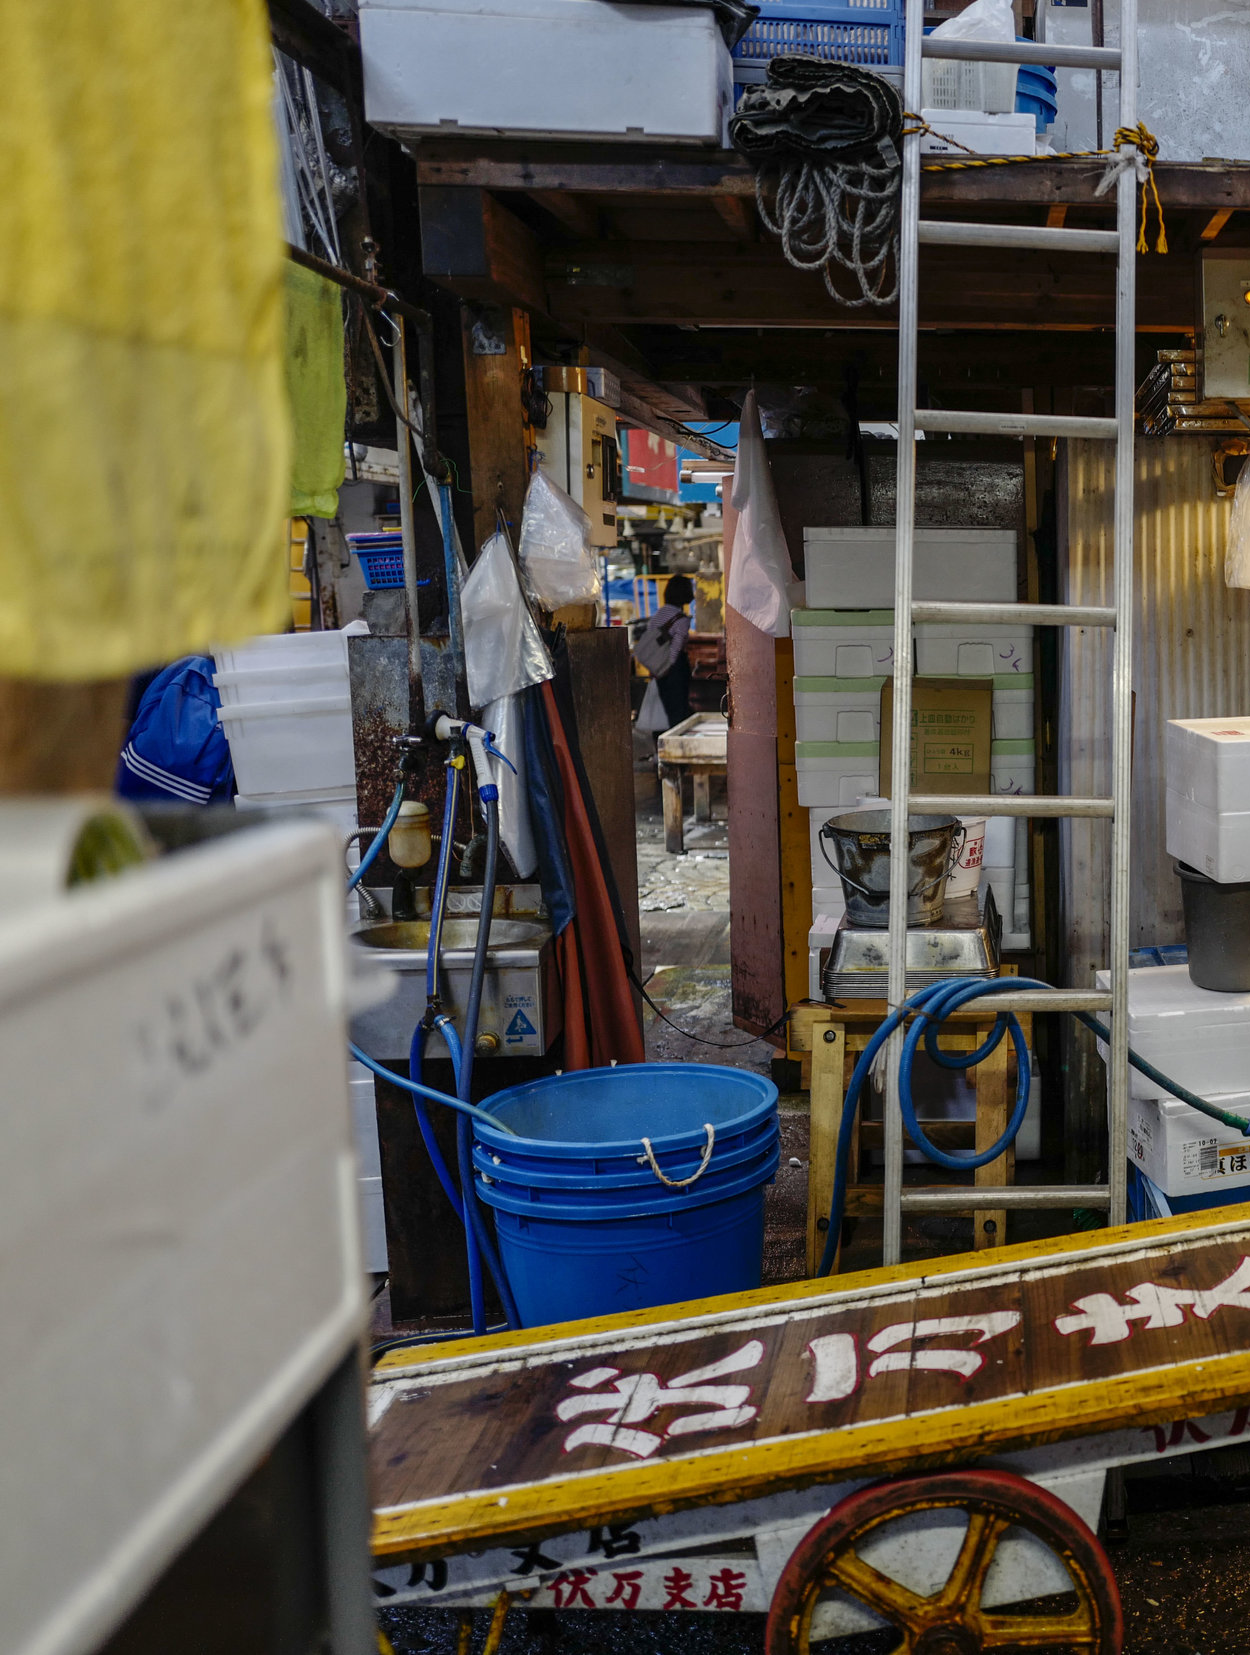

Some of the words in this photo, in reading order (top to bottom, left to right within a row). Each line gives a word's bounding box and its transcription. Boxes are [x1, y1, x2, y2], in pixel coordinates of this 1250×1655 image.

[949, 747, 971, 757] 4kg
[546, 1566, 748, 1611] 伏万支店
